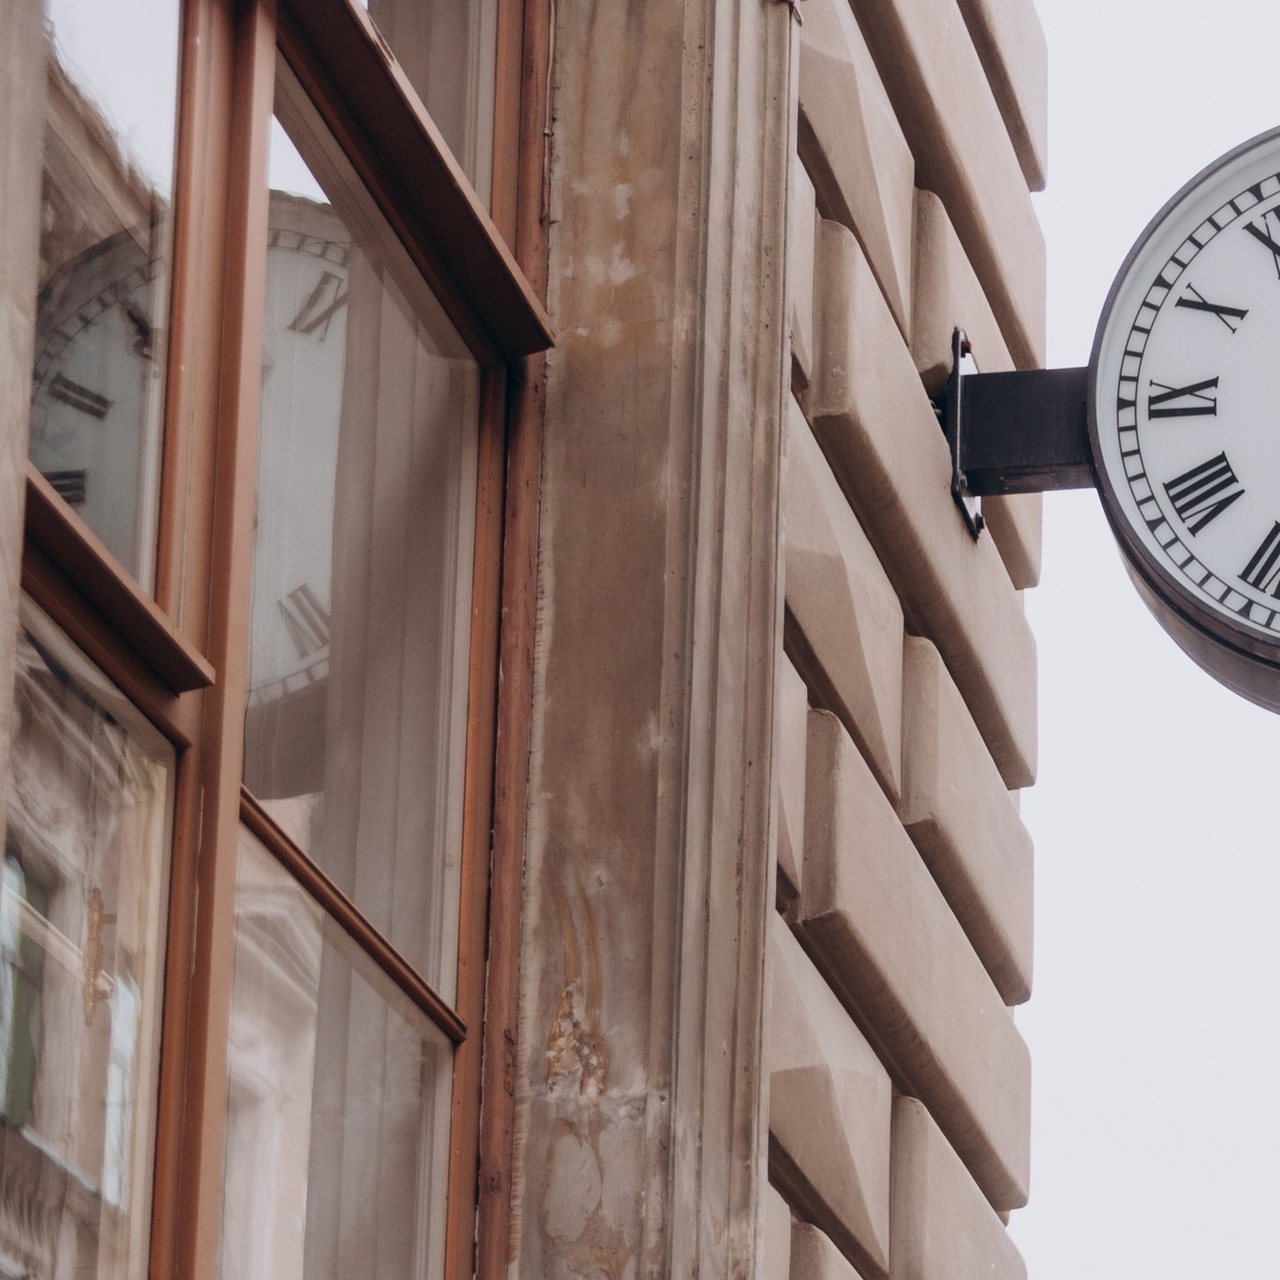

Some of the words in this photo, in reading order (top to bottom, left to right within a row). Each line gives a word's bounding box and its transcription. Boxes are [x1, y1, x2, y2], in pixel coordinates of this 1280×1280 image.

[1175, 282, 1249, 334] X
[1148, 376, 1219, 420] IX
[1163, 451, 1245, 537] VIII
